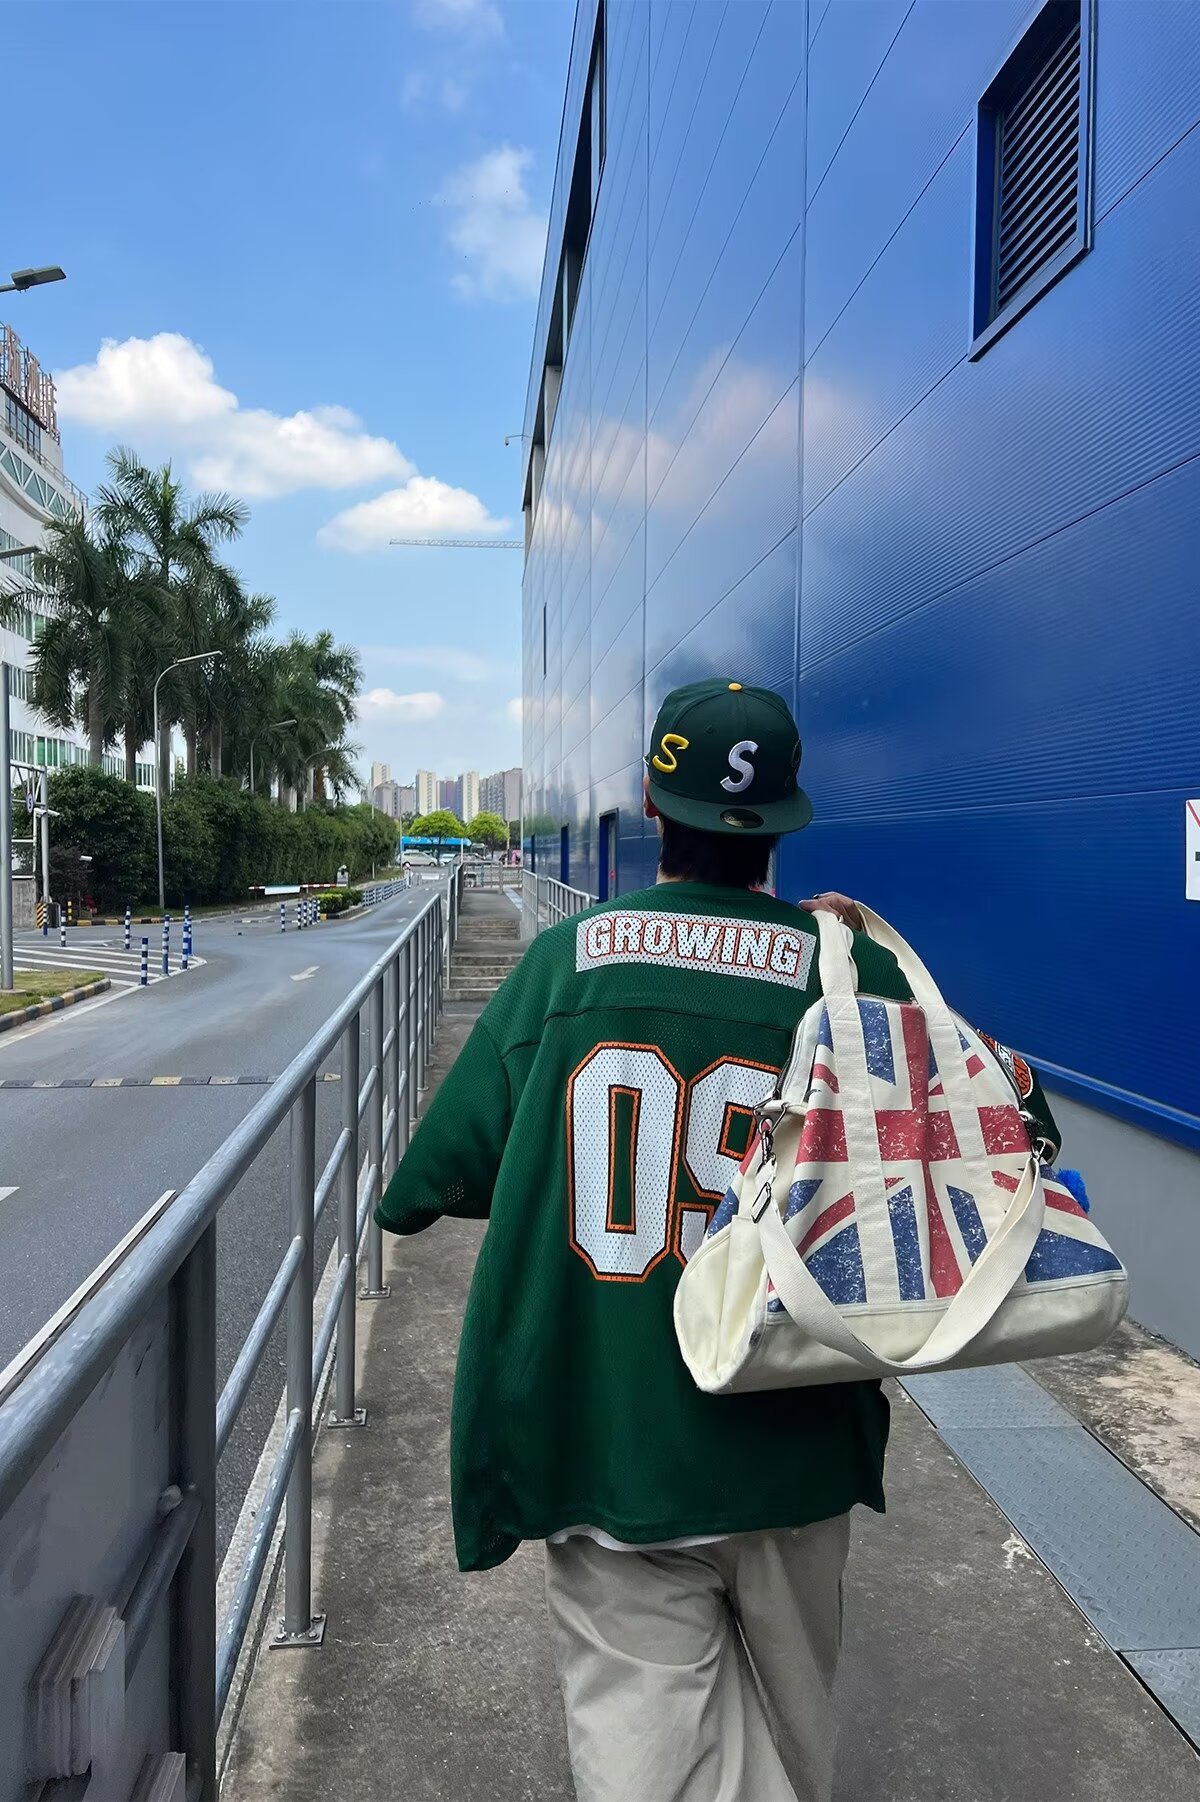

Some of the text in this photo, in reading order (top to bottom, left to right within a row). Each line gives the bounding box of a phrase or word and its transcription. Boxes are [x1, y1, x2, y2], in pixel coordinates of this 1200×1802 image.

[652, 733, 690, 773] S
[719, 740, 760, 793] S
[585, 914, 803, 978] GROWING
